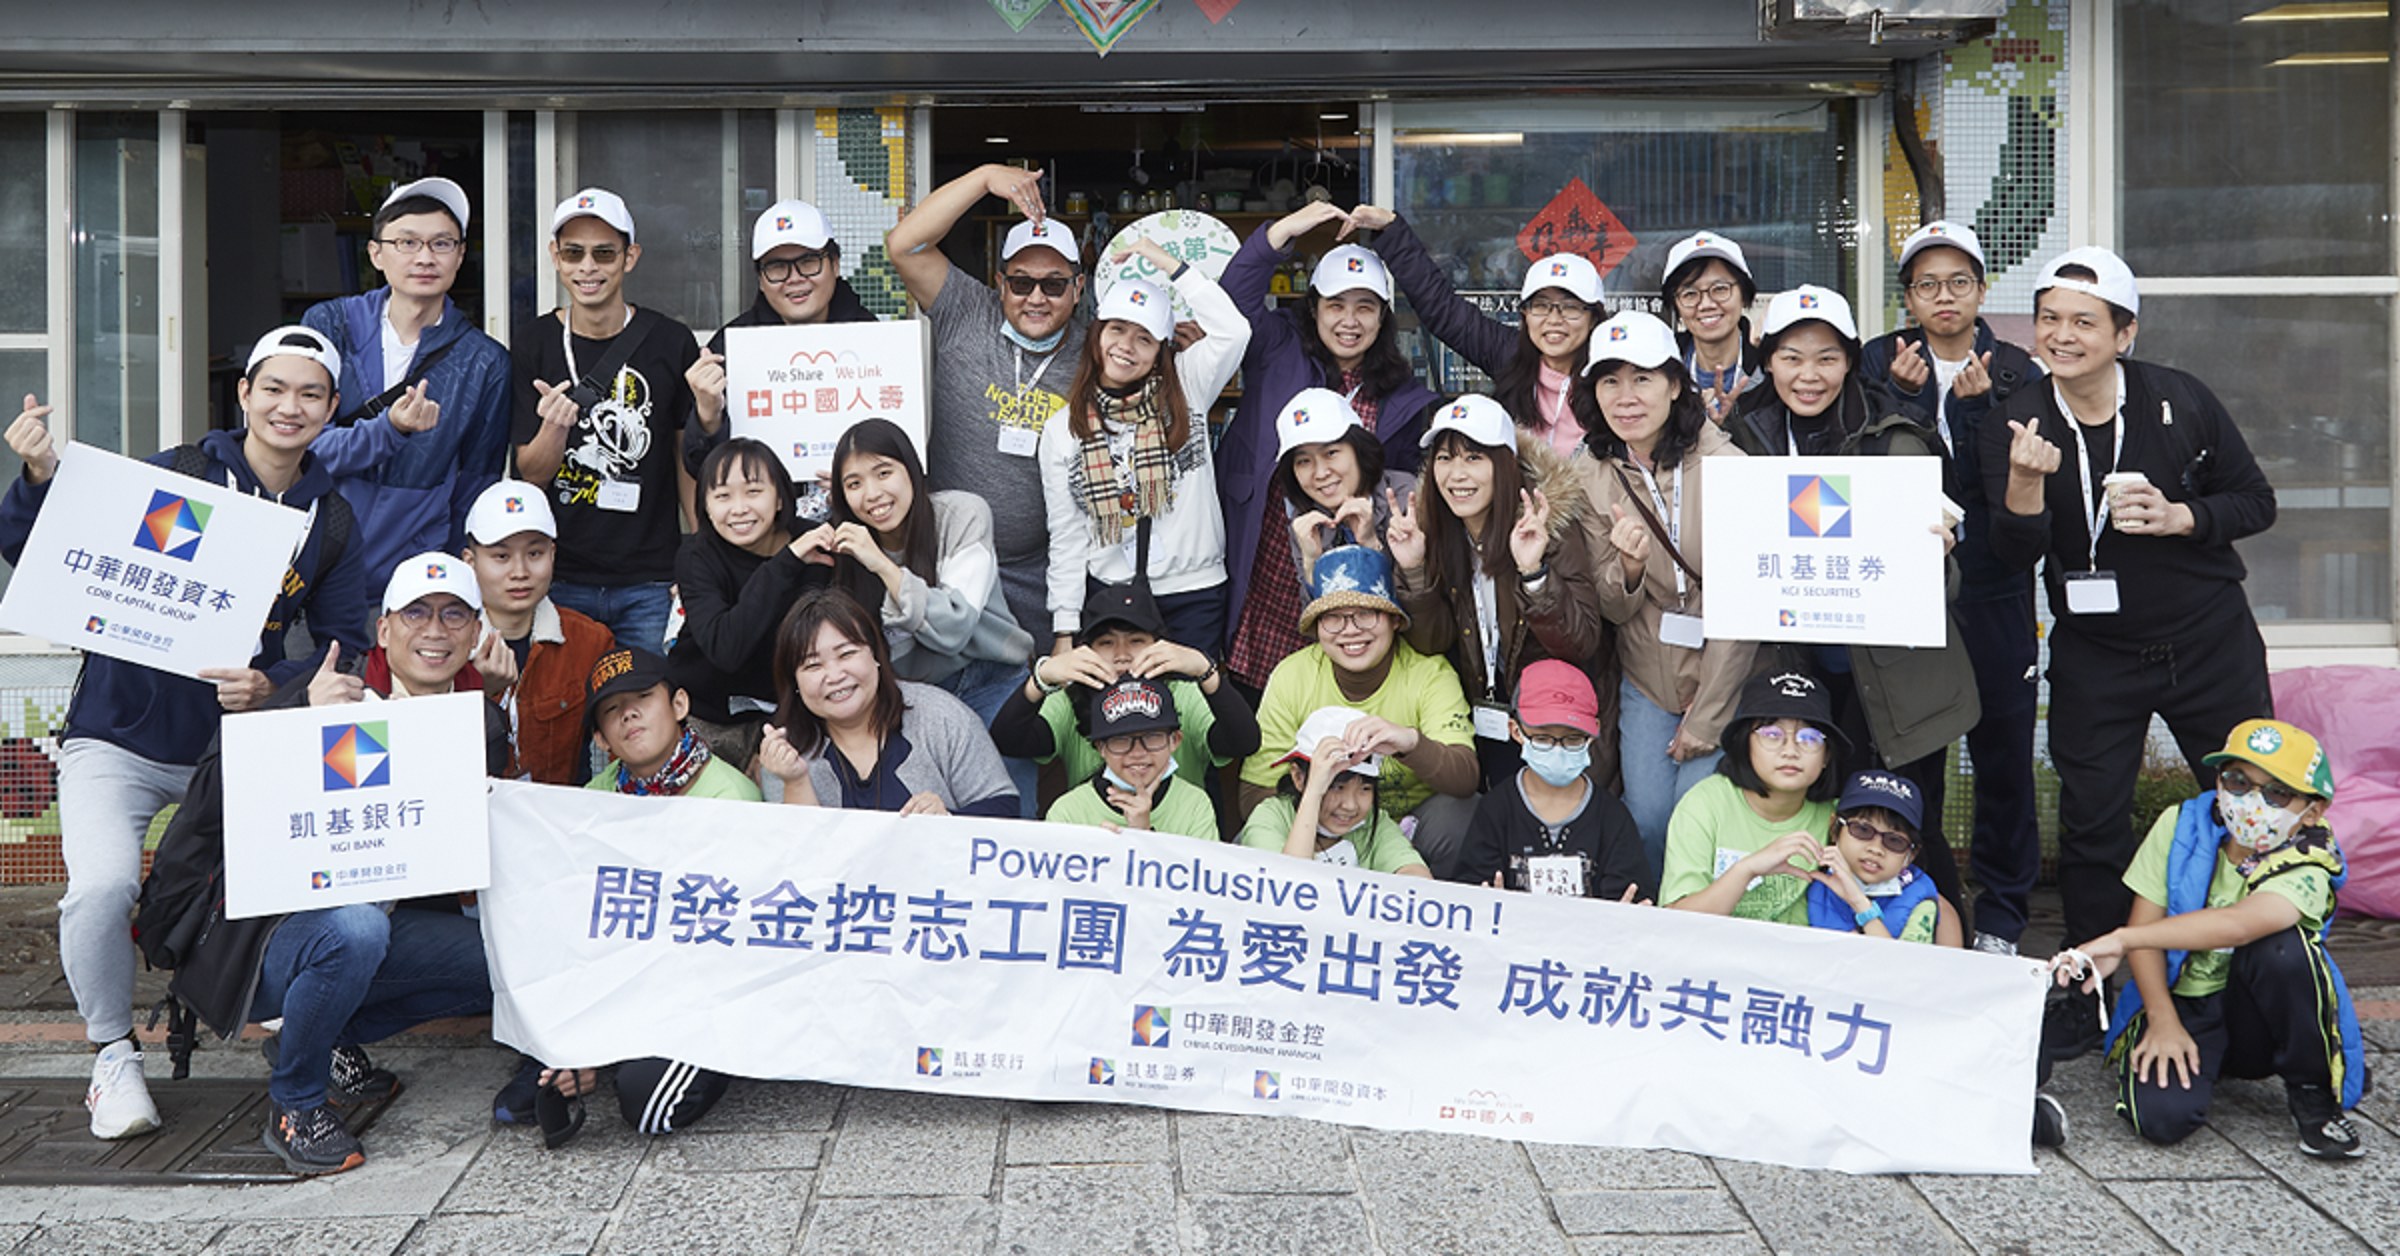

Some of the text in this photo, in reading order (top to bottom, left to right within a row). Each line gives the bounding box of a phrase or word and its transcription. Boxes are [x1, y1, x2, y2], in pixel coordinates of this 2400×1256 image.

[789, 367, 824, 382] Share
[857, 364, 883, 378] Link
[782, 385, 904, 414] 中國人壽
[63, 548, 236, 613] 中華開發資本
[1757, 553, 1886, 582] 凱基證券
[85, 584, 198, 622] CDIB CAPITAL GROUP
[1803, 586, 1862, 598] SECURITIES
[1102, 691, 1161, 723] SQUAD
[289, 799, 425, 839] 凱基銀行
[330, 838, 385, 853] KGI BANK
[969, 837, 1110, 883] Power
[1125, 848, 1319, 912] Inclusive
[1337, 877, 1474, 932] Vision
[588, 864, 1893, 1076] 開發金控志工團 為愛出發 成就共融力
[1184, 1011, 1325, 1047] 中華開發金控
